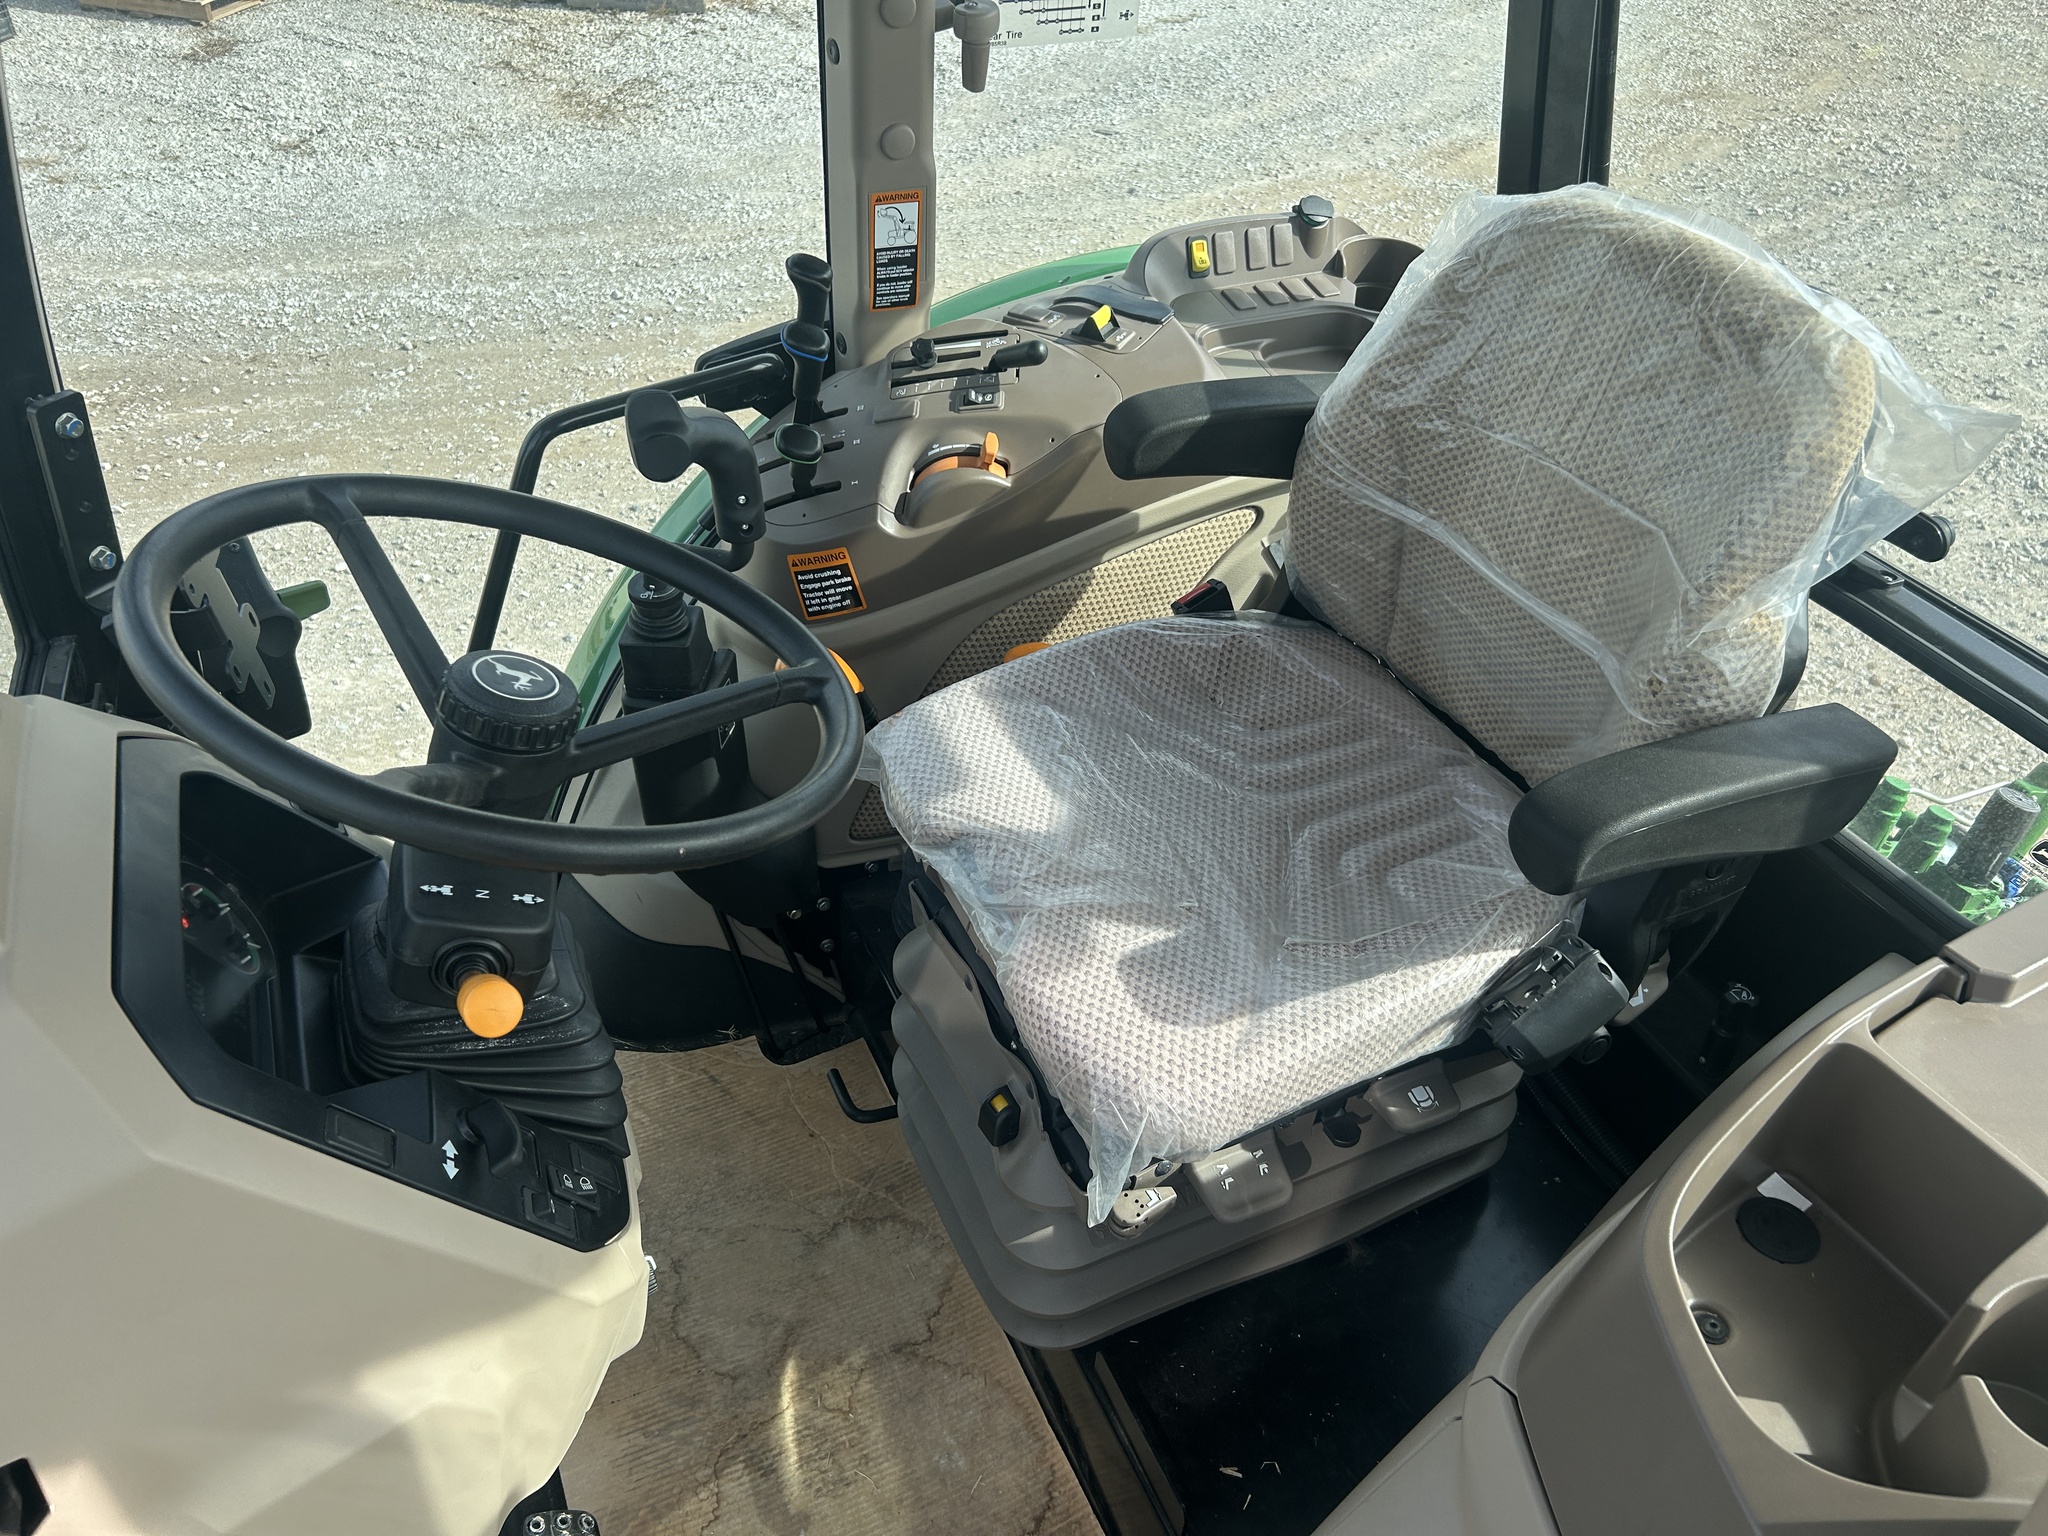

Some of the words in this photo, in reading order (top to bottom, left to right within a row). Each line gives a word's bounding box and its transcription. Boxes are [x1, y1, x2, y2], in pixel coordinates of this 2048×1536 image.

[1006, 30, 1022, 39] Tire
[881, 192, 919, 202] WARNING
[798, 552, 846, 566] WARNING
[814, 569, 841, 578] crushing
[821, 602, 841, 610] engine
